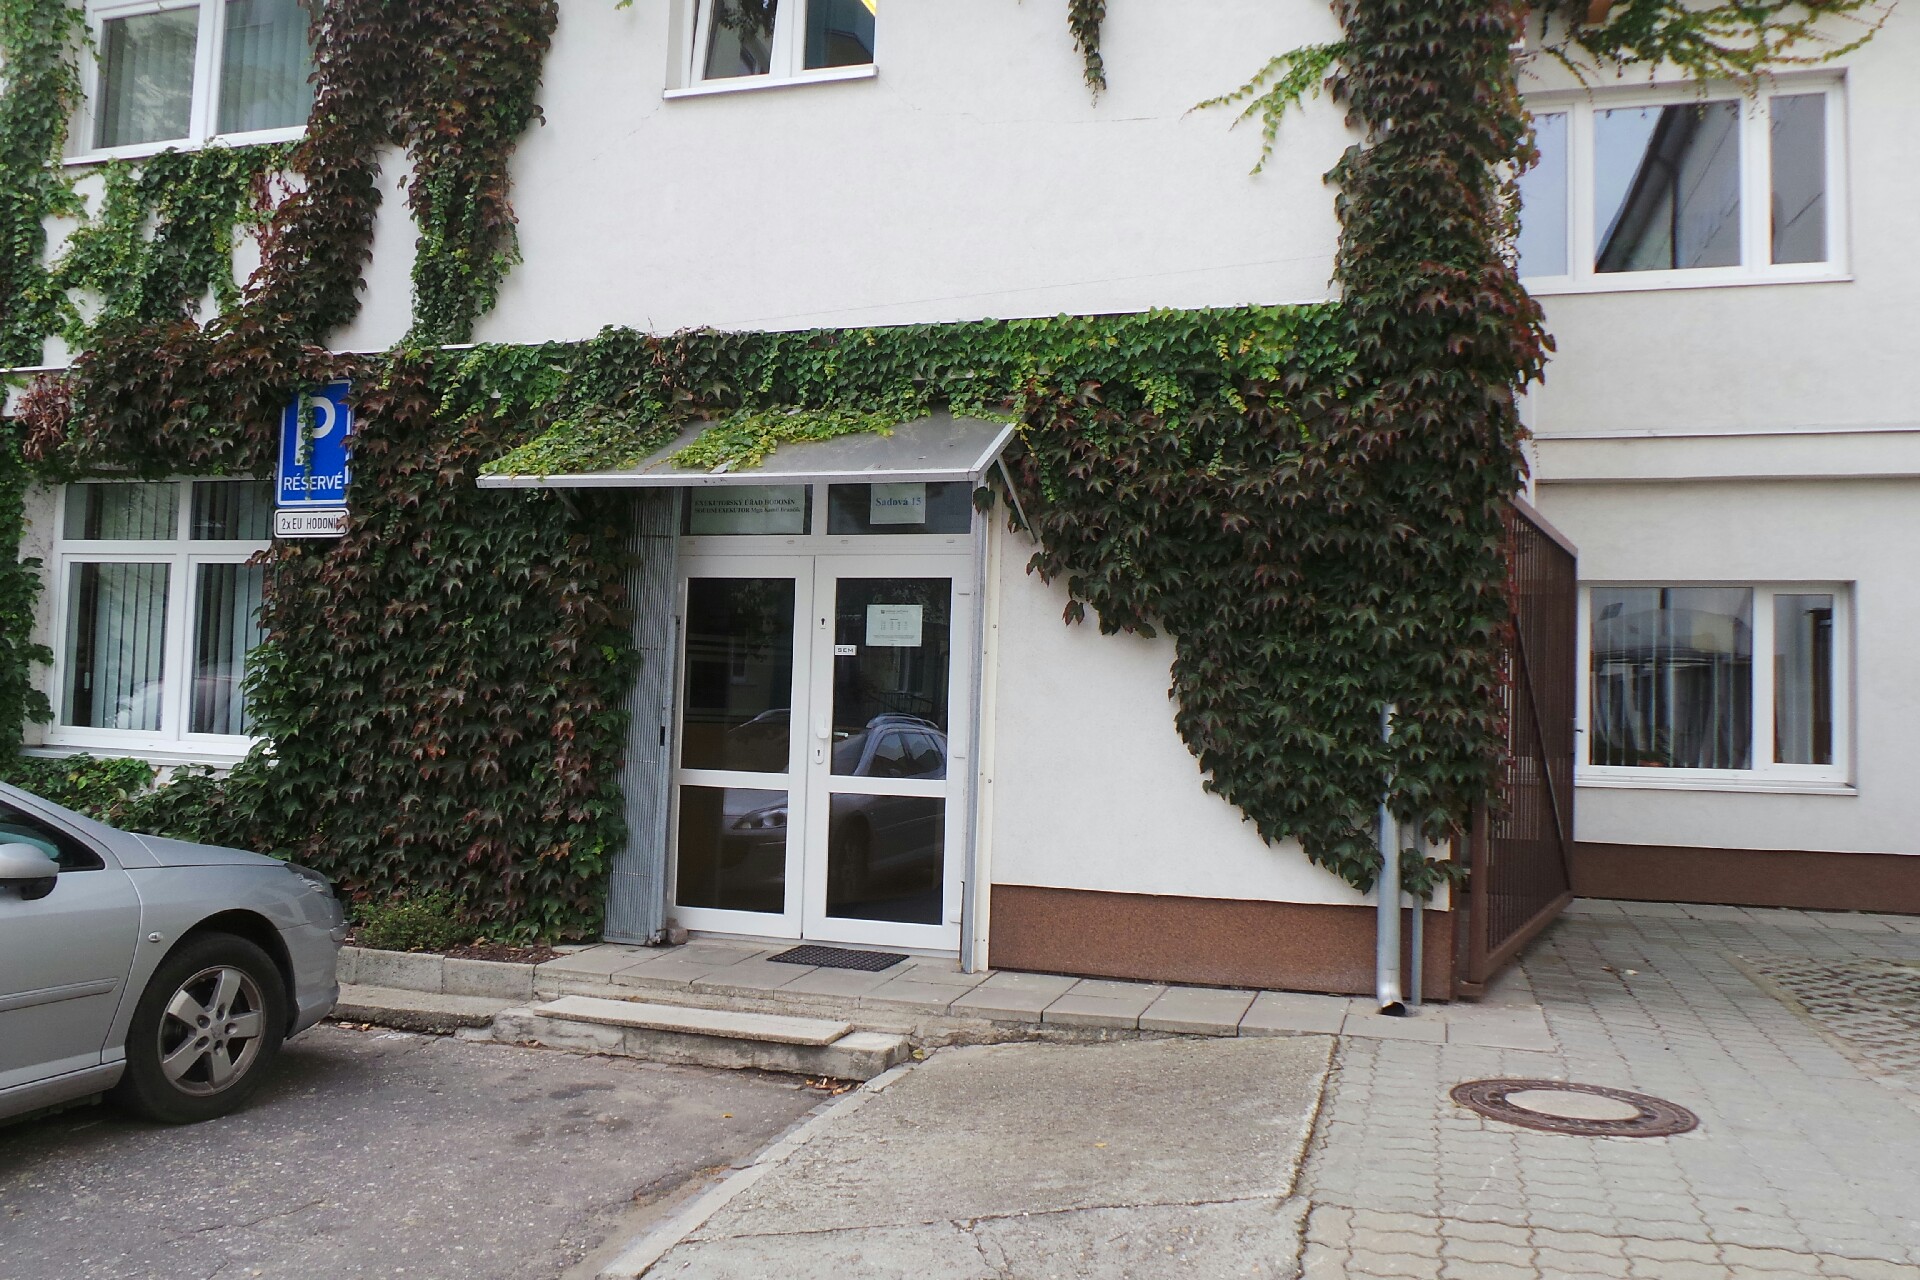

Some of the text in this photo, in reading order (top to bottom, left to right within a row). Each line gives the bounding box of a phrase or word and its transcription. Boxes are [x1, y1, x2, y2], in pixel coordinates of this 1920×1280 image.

[294, 396, 336, 466] P
[283, 471, 343, 491] RÉSERVÉ
[875, 496, 922, 507] Sadová 15
